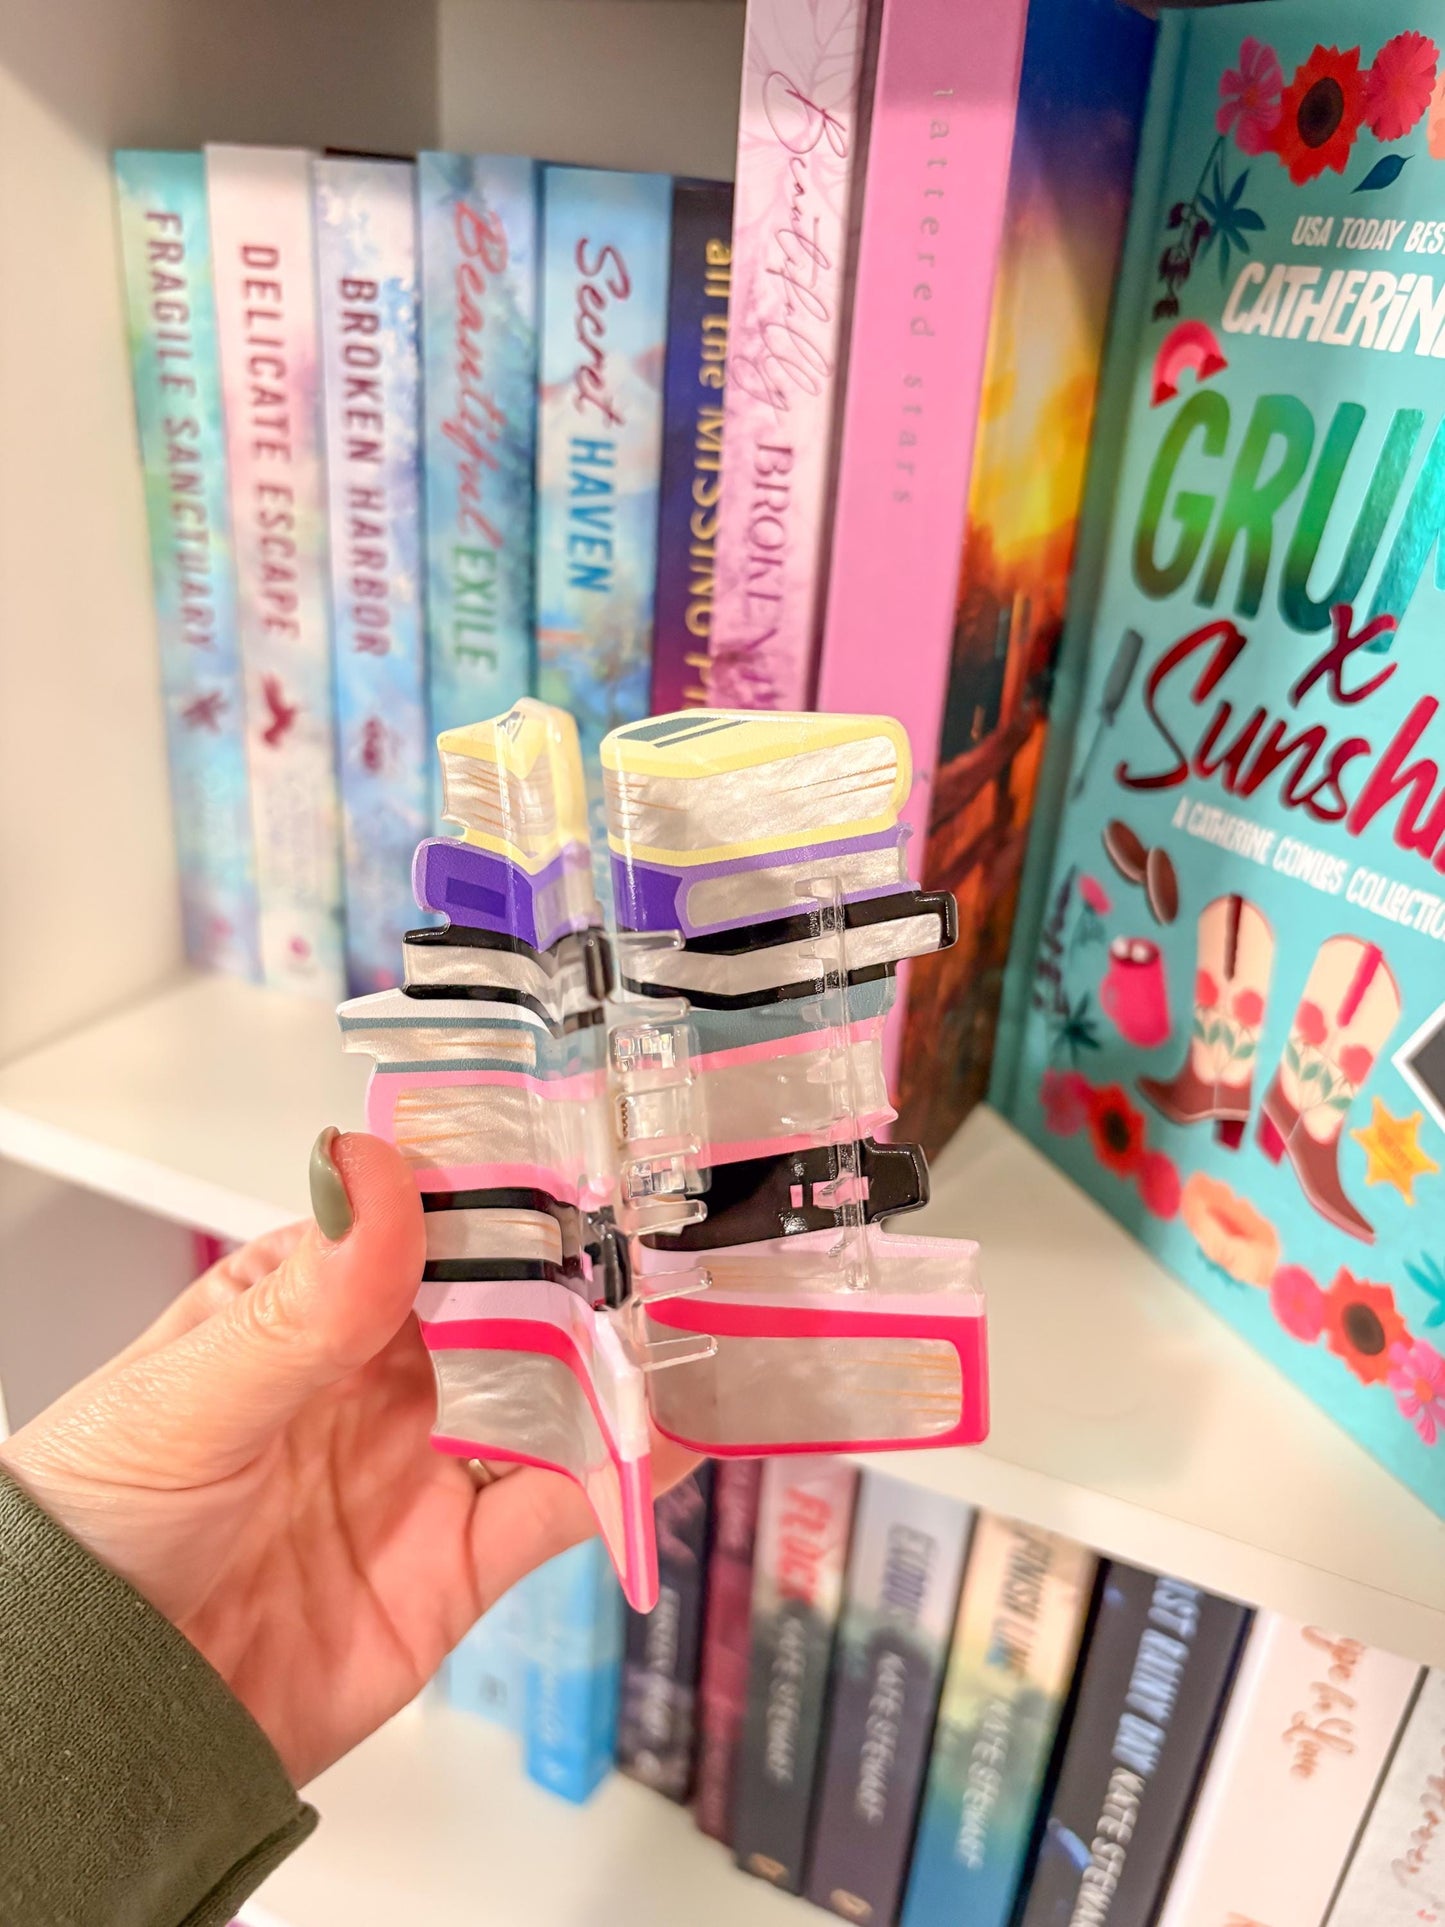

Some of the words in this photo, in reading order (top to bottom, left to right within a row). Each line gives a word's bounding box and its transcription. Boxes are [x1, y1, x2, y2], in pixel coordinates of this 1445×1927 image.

[143, 208, 198, 399] FRAGILE
[729, 70, 848, 424] Beautifully
[1291, 215, 1333, 247] USA
[1335, 217, 1407, 251] TODAY
[1404, 220, 1445, 256] BES
[240, 242, 292, 464] DELICATE
[338, 276, 386, 465] BROKEN
[440, 200, 508, 550] Beautiful
[571, 236, 632, 427] Secret
[567, 437, 617, 593] HAVEN
[893, 375, 924, 504] stars
[162, 415, 218, 653] SANCTUARY
[252, 484, 300, 642] ESCAPE
[346, 486, 393, 658] HARBOR
[450, 542, 498, 673] EXILE
[1171, 796, 1188, 828] A
[1187, 801, 1277, 866] CATHERINE
[1097, 1766, 1146, 1844] KATE
[1112, 1712, 1166, 1777] DAY
